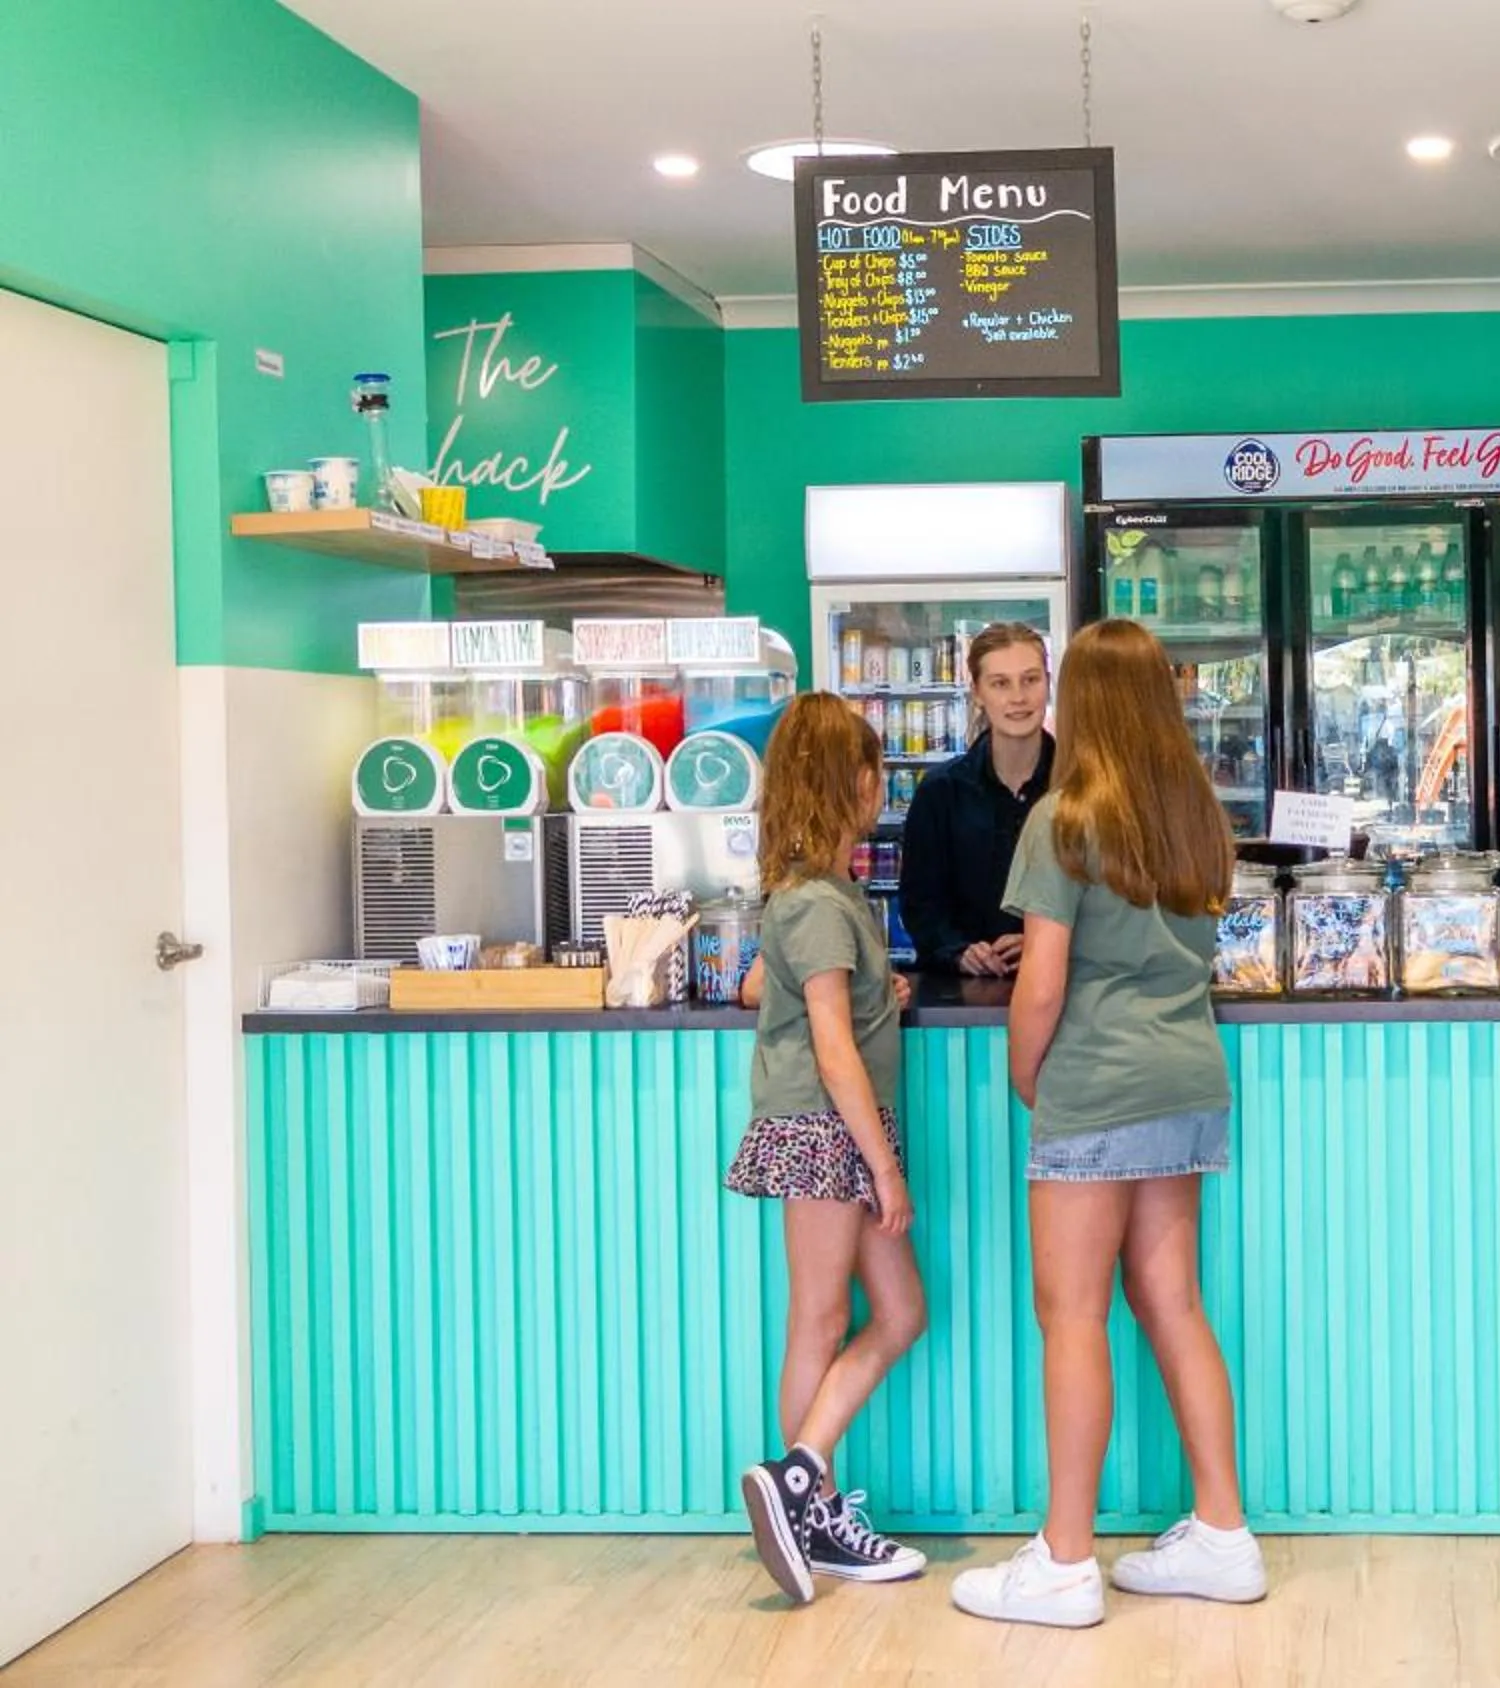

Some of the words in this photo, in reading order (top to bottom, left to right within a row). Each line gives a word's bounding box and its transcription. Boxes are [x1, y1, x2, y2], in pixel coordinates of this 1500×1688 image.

[823, 176, 907, 217] Food
[940, 176, 1046, 213] Menu
[818, 227, 853, 248] HOT
[863, 225, 901, 247] FOOD
[967, 225, 1021, 247] SIDES
[1029, 308, 1073, 326] Chicken
[433, 311, 559, 407] The
[426, 414, 592, 506] hack
[1234, 451, 1270, 466] COOL
[1295, 437, 1341, 477] Do
[1422, 430, 1473, 472] Feel
[1231, 464, 1274, 482] RIDGE
